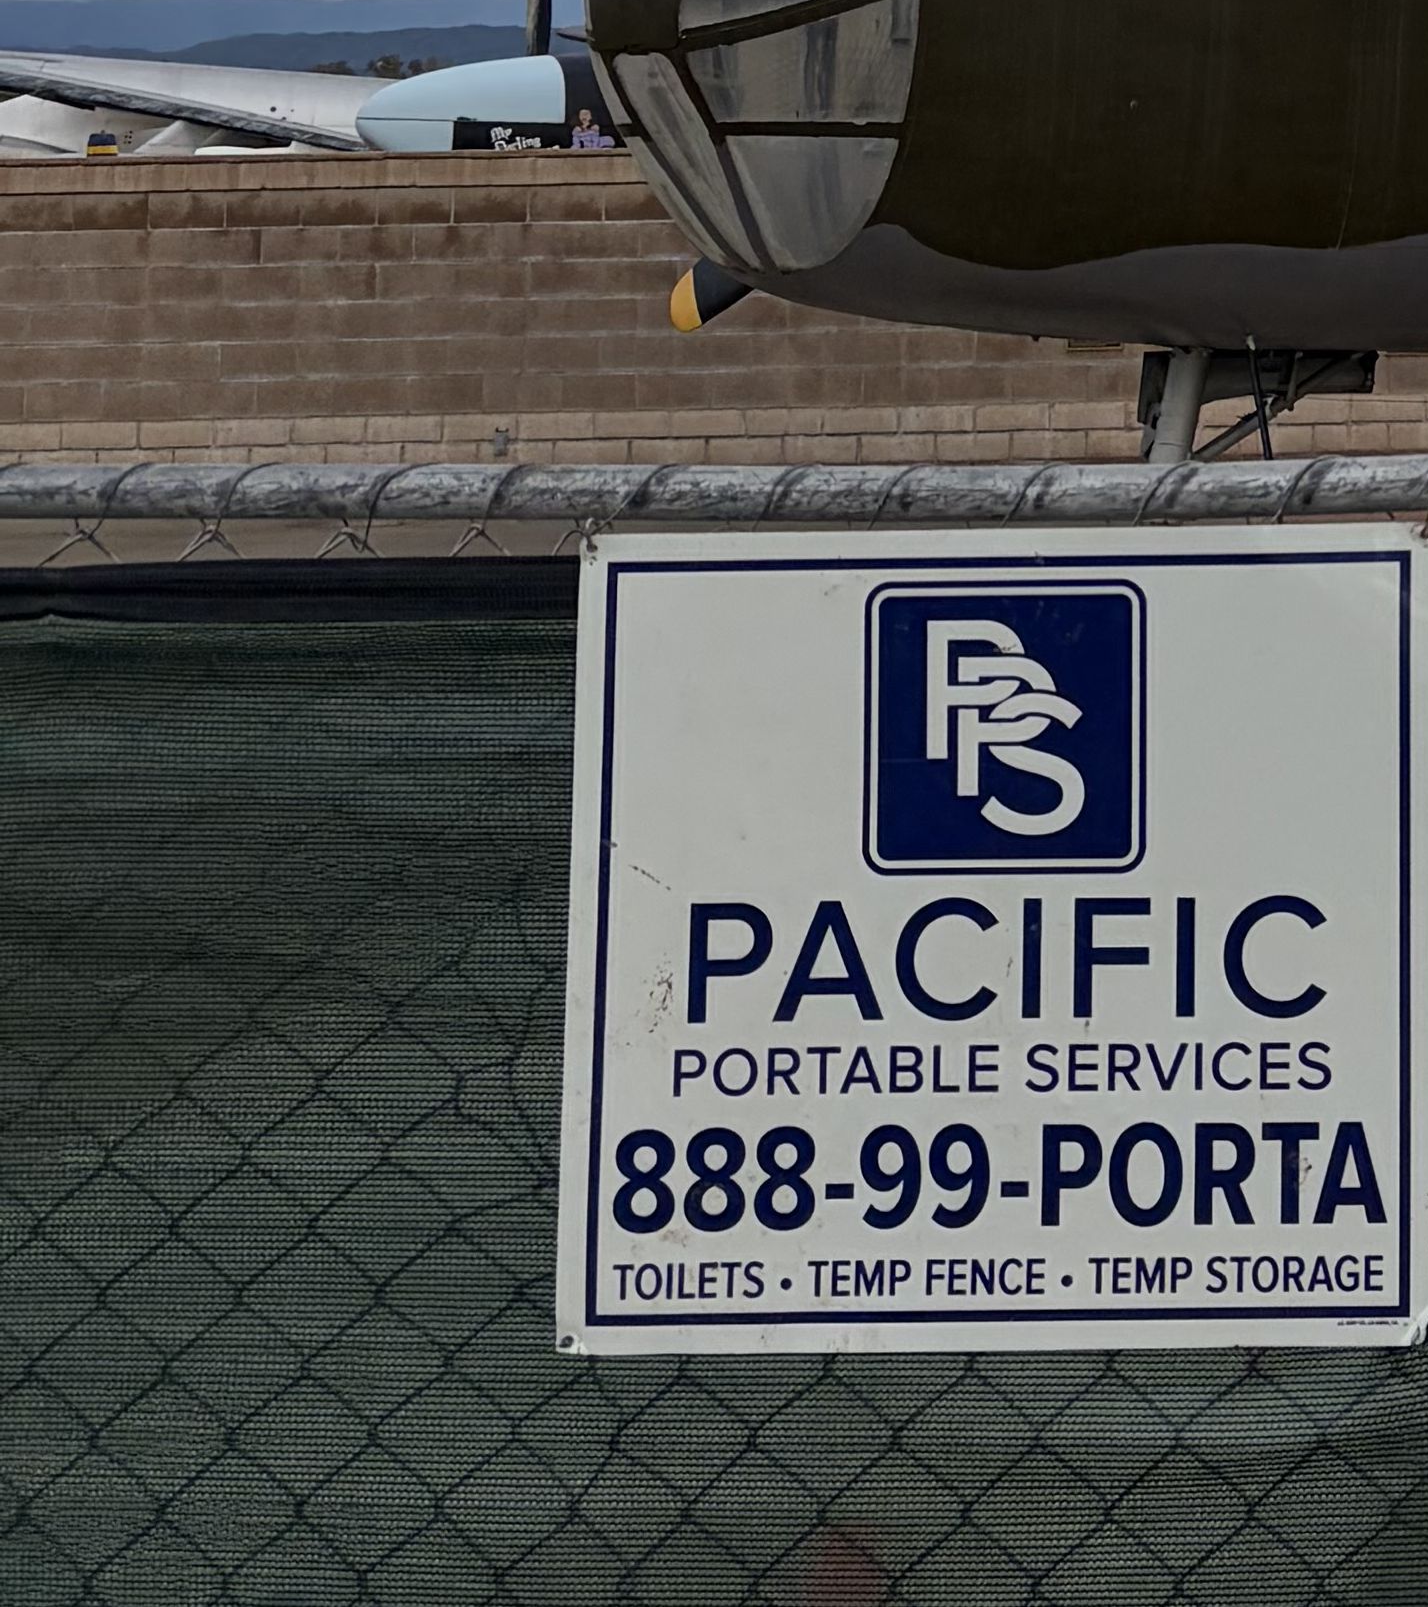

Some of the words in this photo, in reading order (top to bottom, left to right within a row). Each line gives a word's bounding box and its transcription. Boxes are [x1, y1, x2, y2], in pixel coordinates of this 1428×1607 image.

[491, 126, 513, 142] My
[927, 620, 1085, 836] PPS
[687, 894, 1327, 1024] PACIFIC
[673, 1044, 1000, 1097] PORTABLE
[1025, 1042, 1332, 1093] SERVICES
[612, 1121, 1388, 1234] 888-99-PORTA
[613, 1261, 765, 1301] TOILETS
[808, 1259, 912, 1298] TEMP
[926, 1258, 1046, 1296] FENCE
[1089, 1256, 1193, 1295] TEMP
[1206, 1255, 1384, 1294] STORAGE
